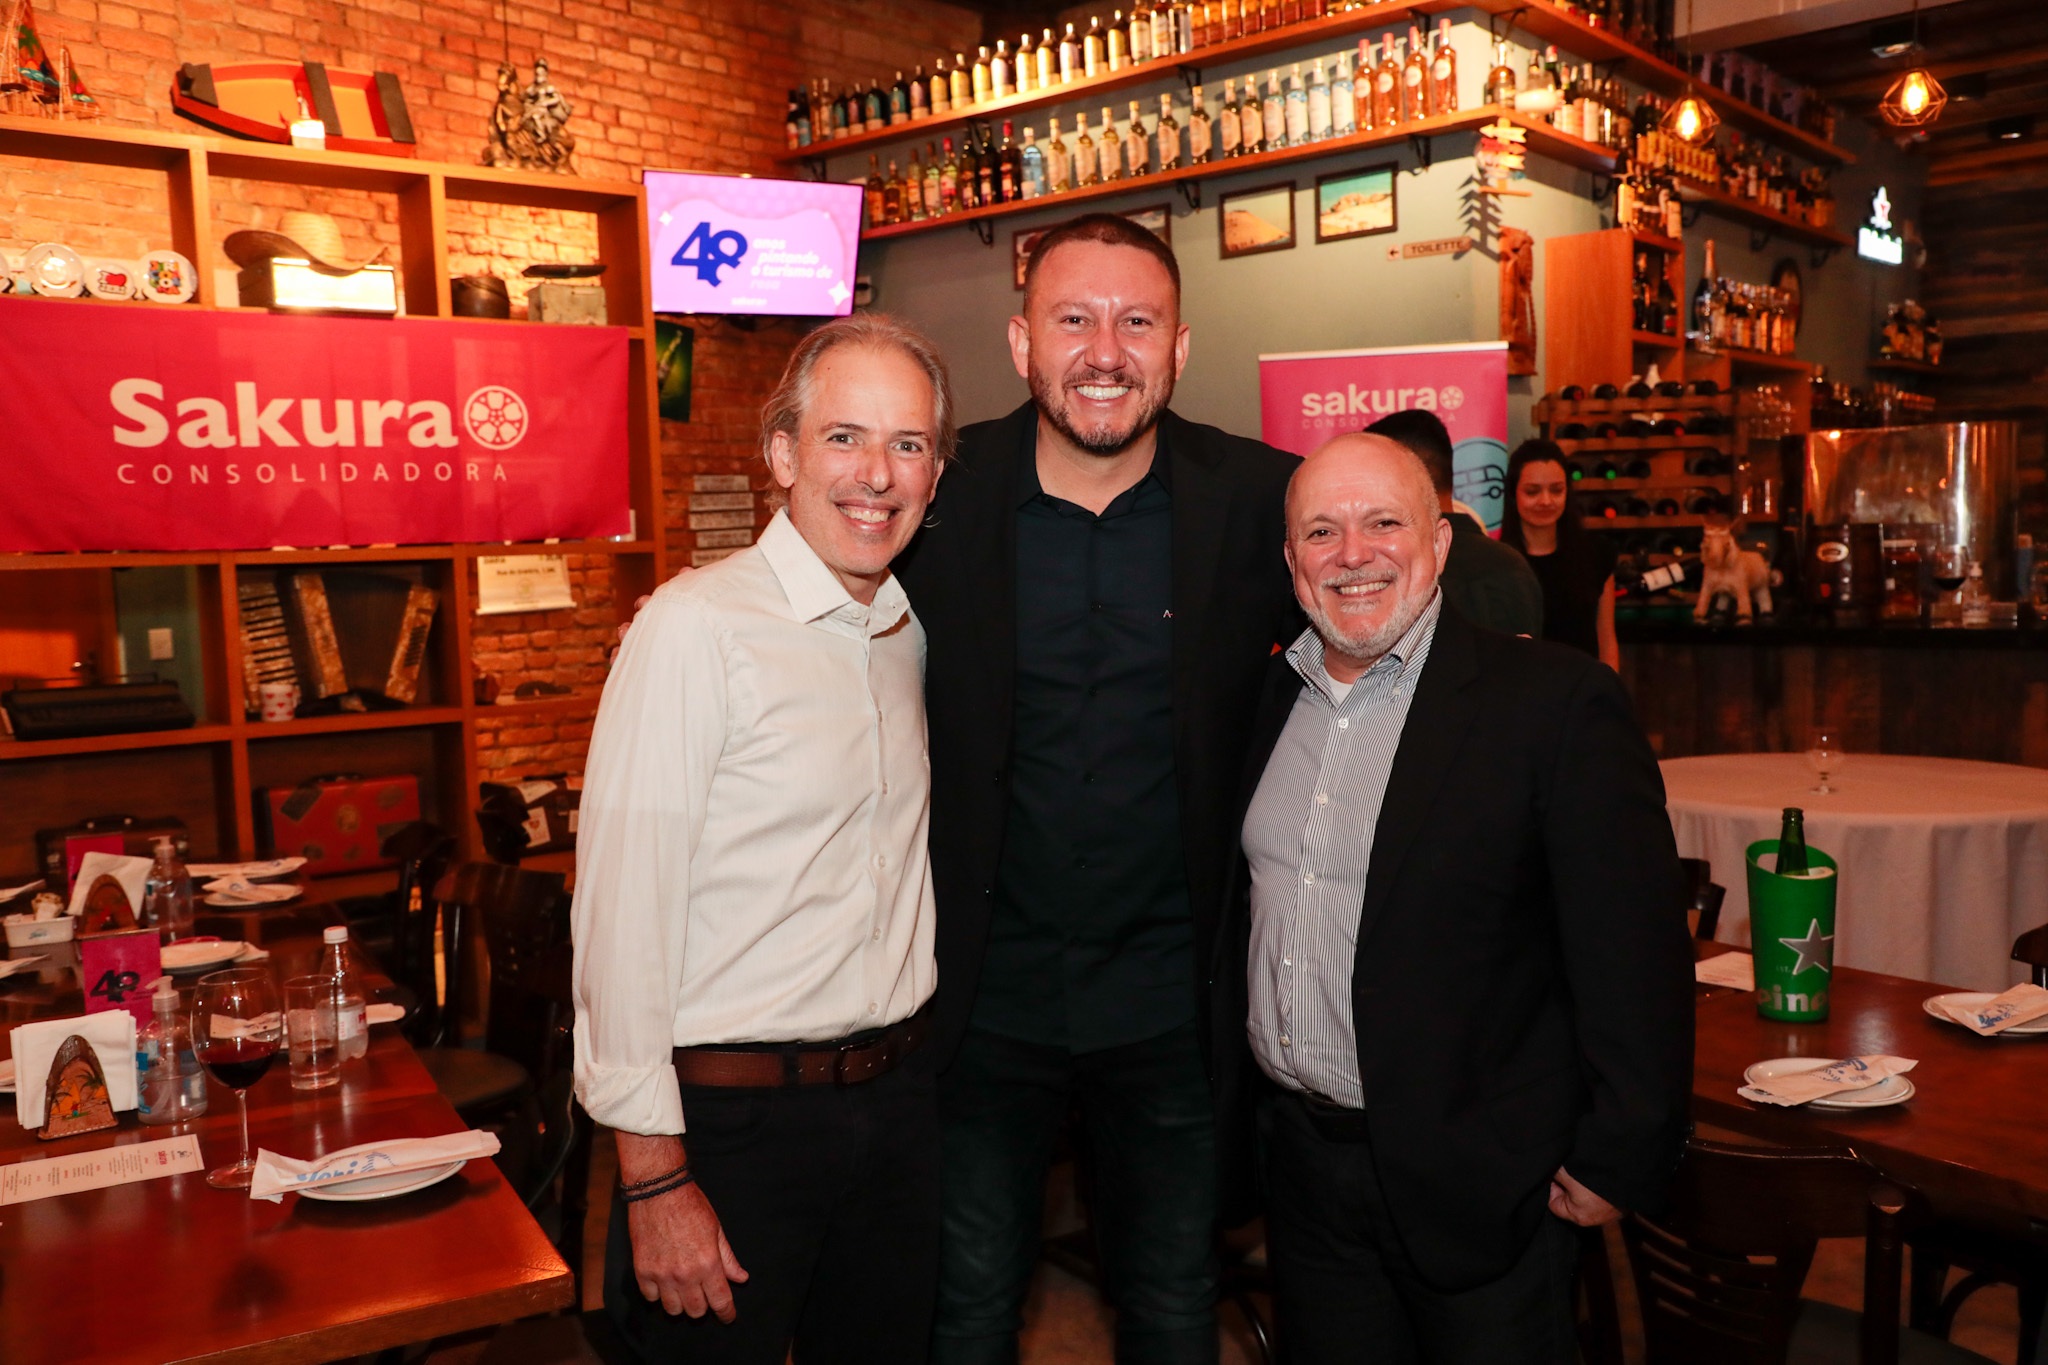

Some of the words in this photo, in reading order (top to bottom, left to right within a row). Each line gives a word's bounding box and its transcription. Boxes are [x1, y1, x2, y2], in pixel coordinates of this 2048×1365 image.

[1411, 241, 1464, 254] TOILETTE
[758, 250, 819, 267] pintando
[762, 265, 815, 278] turismo
[1301, 383, 1438, 417] sakura
[110, 378, 459, 449] Sakura
[116, 462, 508, 485] CONSOLIDADORA
